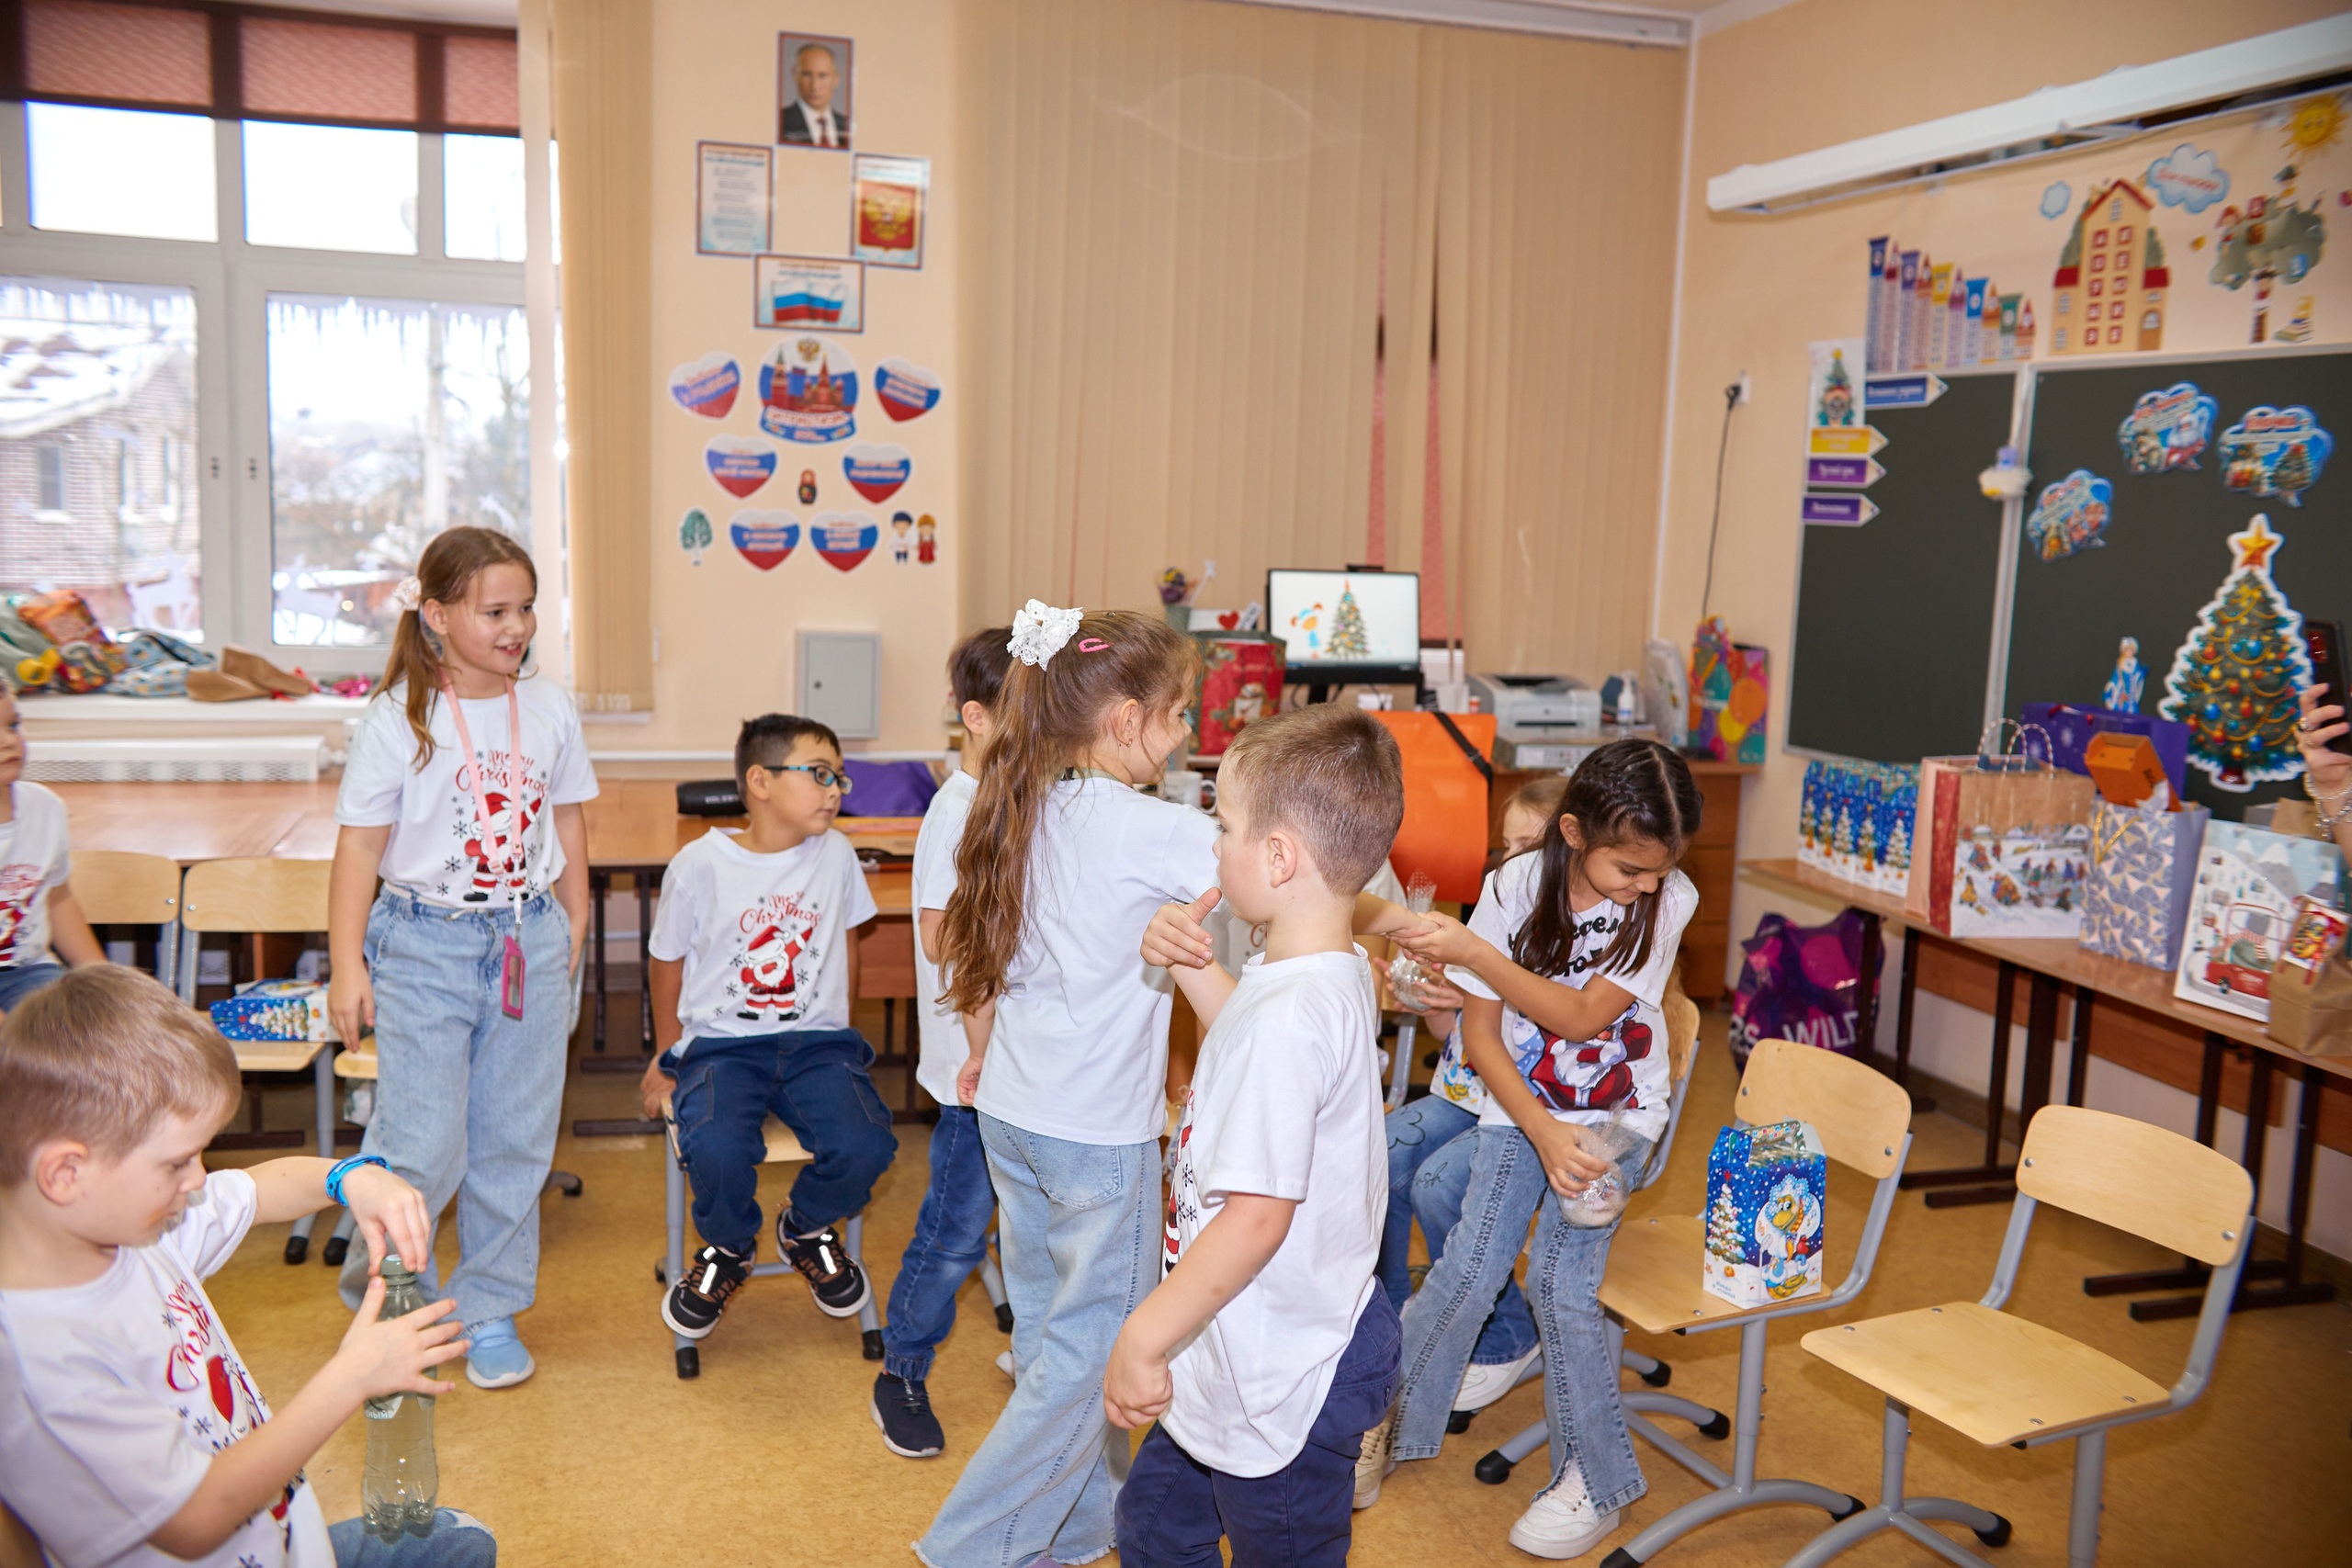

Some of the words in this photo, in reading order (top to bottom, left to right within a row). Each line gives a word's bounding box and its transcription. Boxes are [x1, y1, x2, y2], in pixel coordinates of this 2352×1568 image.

[488, 750, 534, 771] Mery
[456, 763, 549, 799] Chrismas
[768, 891, 806, 908] Mey
